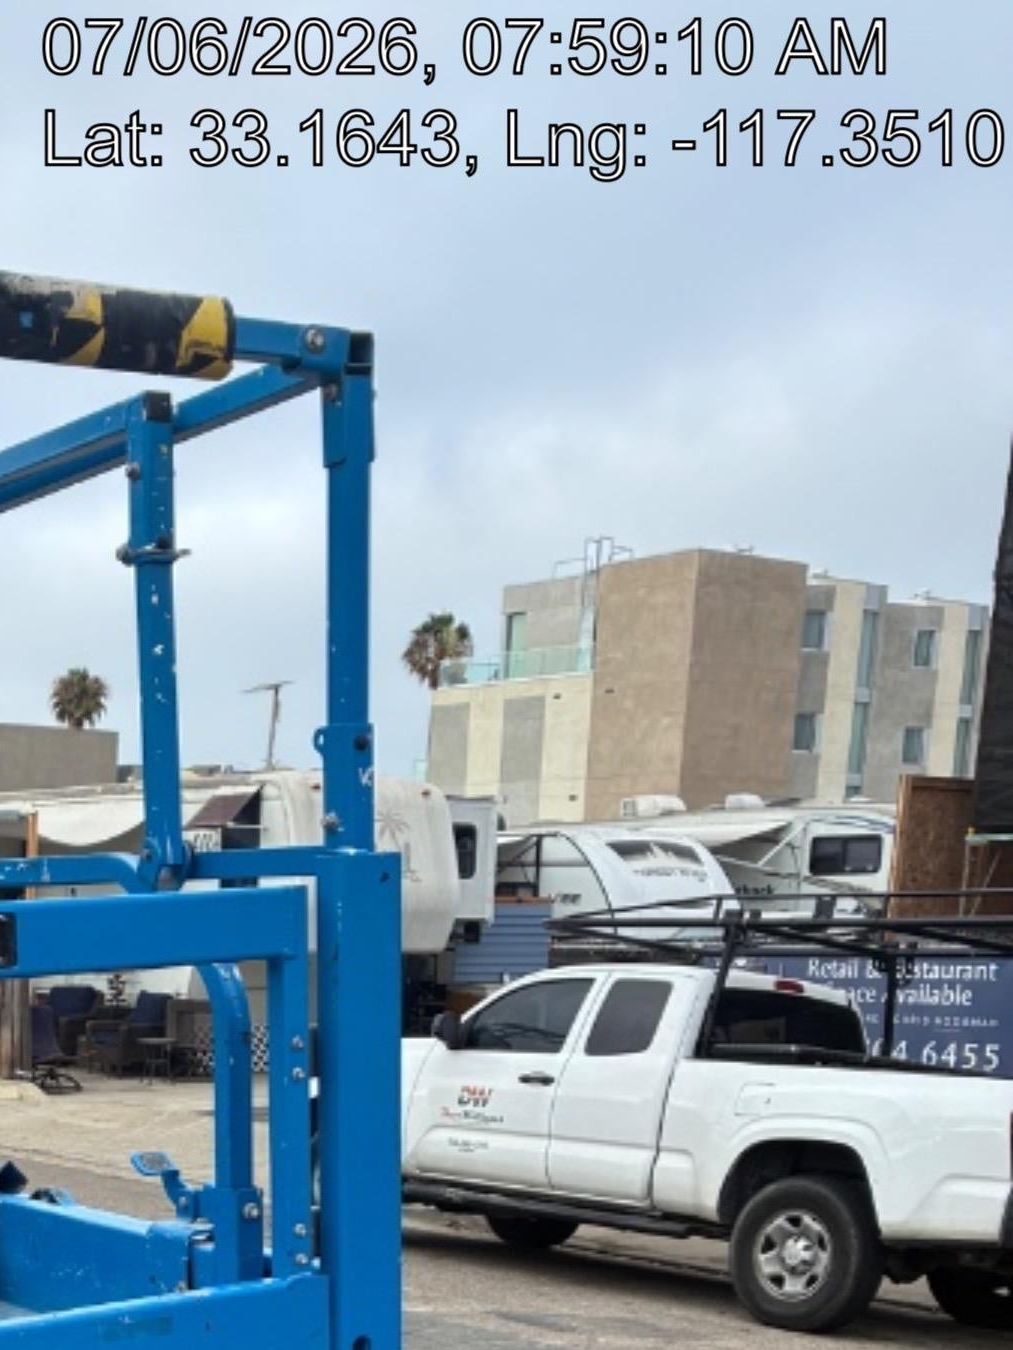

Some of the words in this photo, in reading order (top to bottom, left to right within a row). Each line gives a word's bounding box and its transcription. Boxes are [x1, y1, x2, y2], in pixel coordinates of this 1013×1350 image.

[808, 957, 859, 979] Retail
[895, 960, 999, 982] staurant
[880, 982, 973, 1007] vailable
[922, 1040, 1000, 1072] 6455
